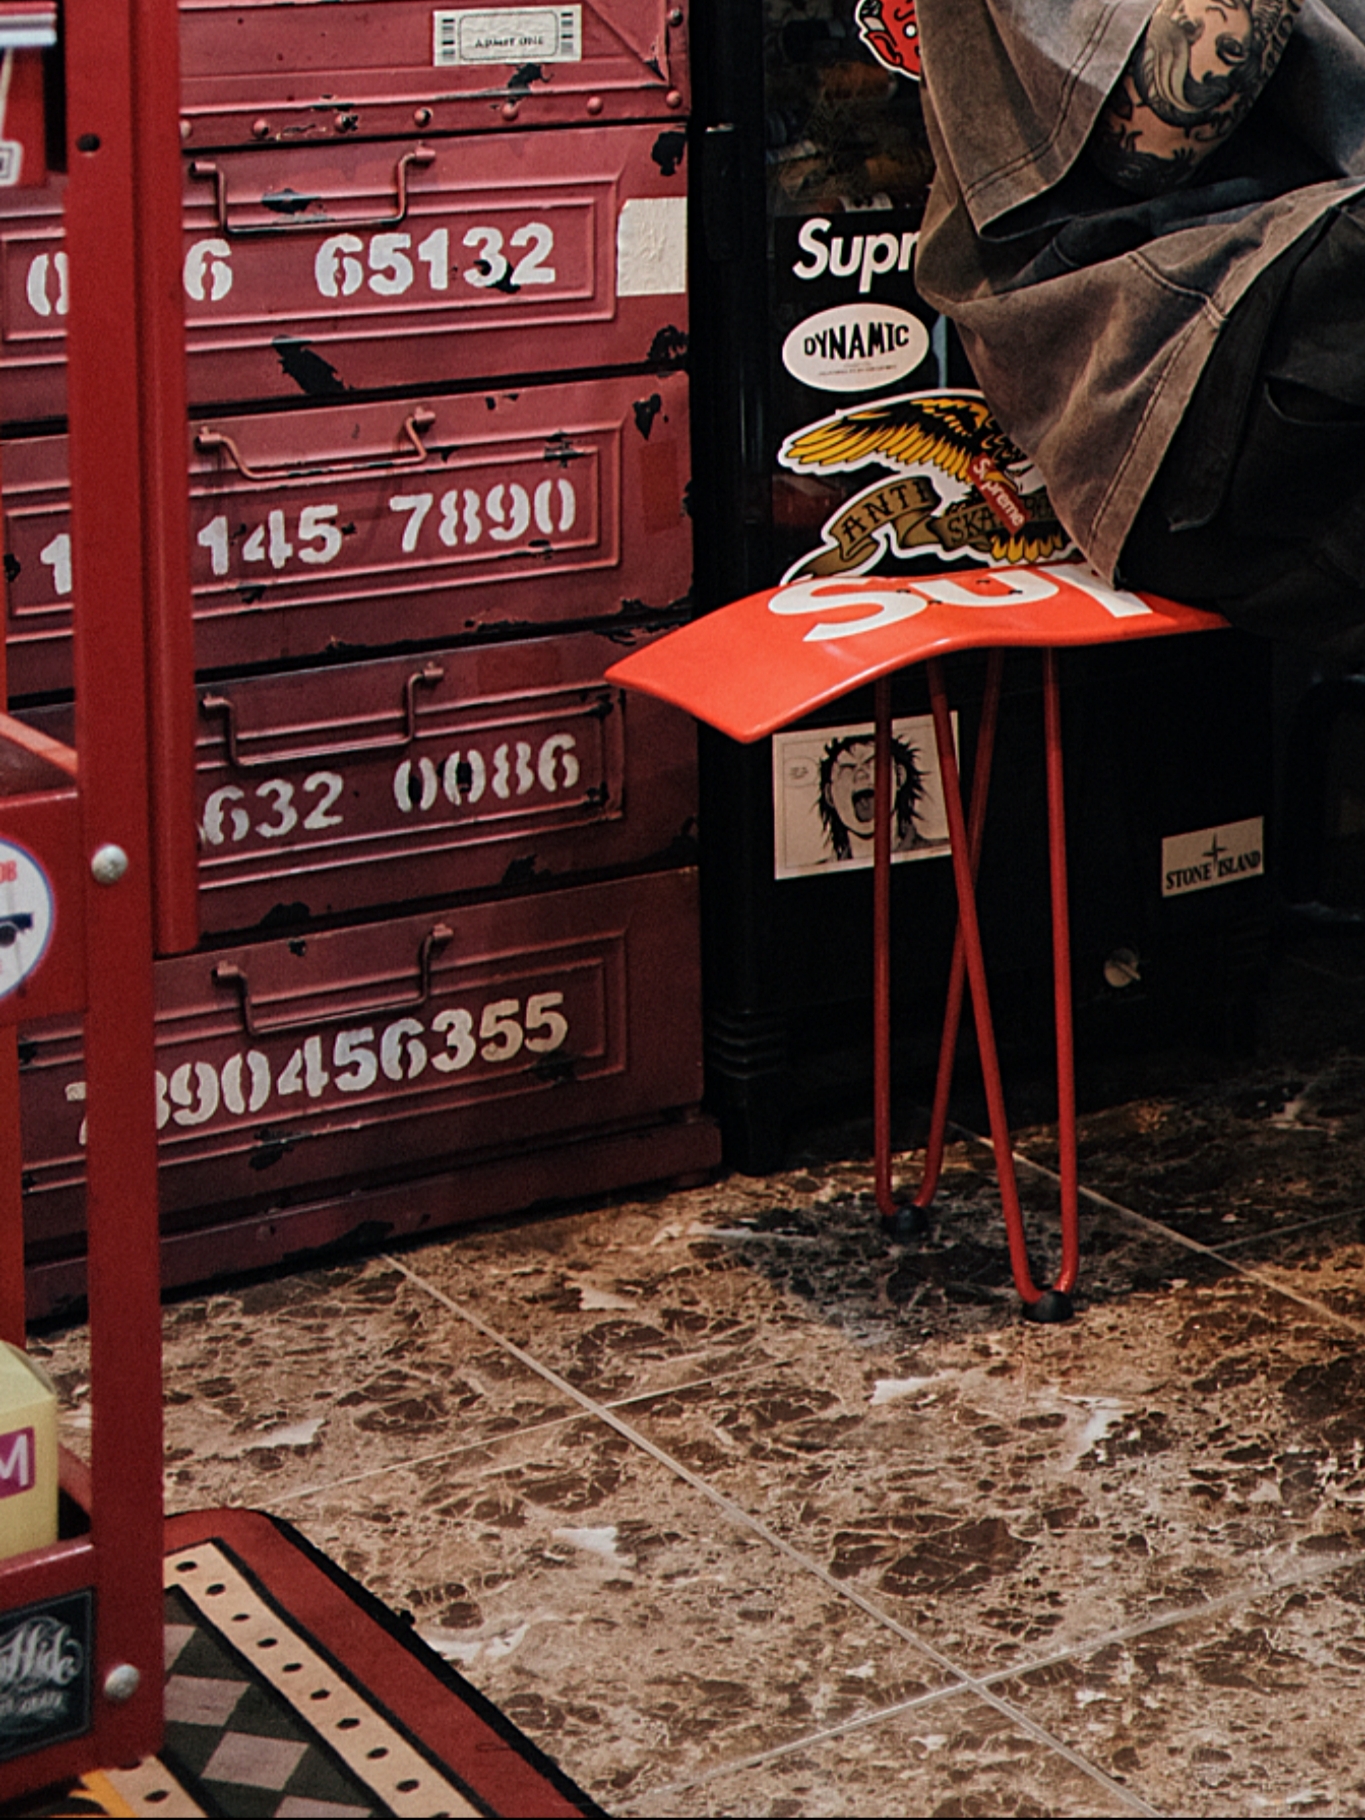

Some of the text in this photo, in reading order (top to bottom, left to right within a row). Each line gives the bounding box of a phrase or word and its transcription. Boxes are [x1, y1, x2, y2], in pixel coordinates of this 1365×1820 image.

[315, 223, 556, 297] 65132
[804, 321, 909, 360] DYNAMIC
[390, 479, 576, 552] 7890
[842, 479, 930, 544] ANTI
[973, 457, 1025, 527] Spreme
[196, 734, 579, 847] 632 0086
[1165, 849, 1262, 890] STONE ISLAND
